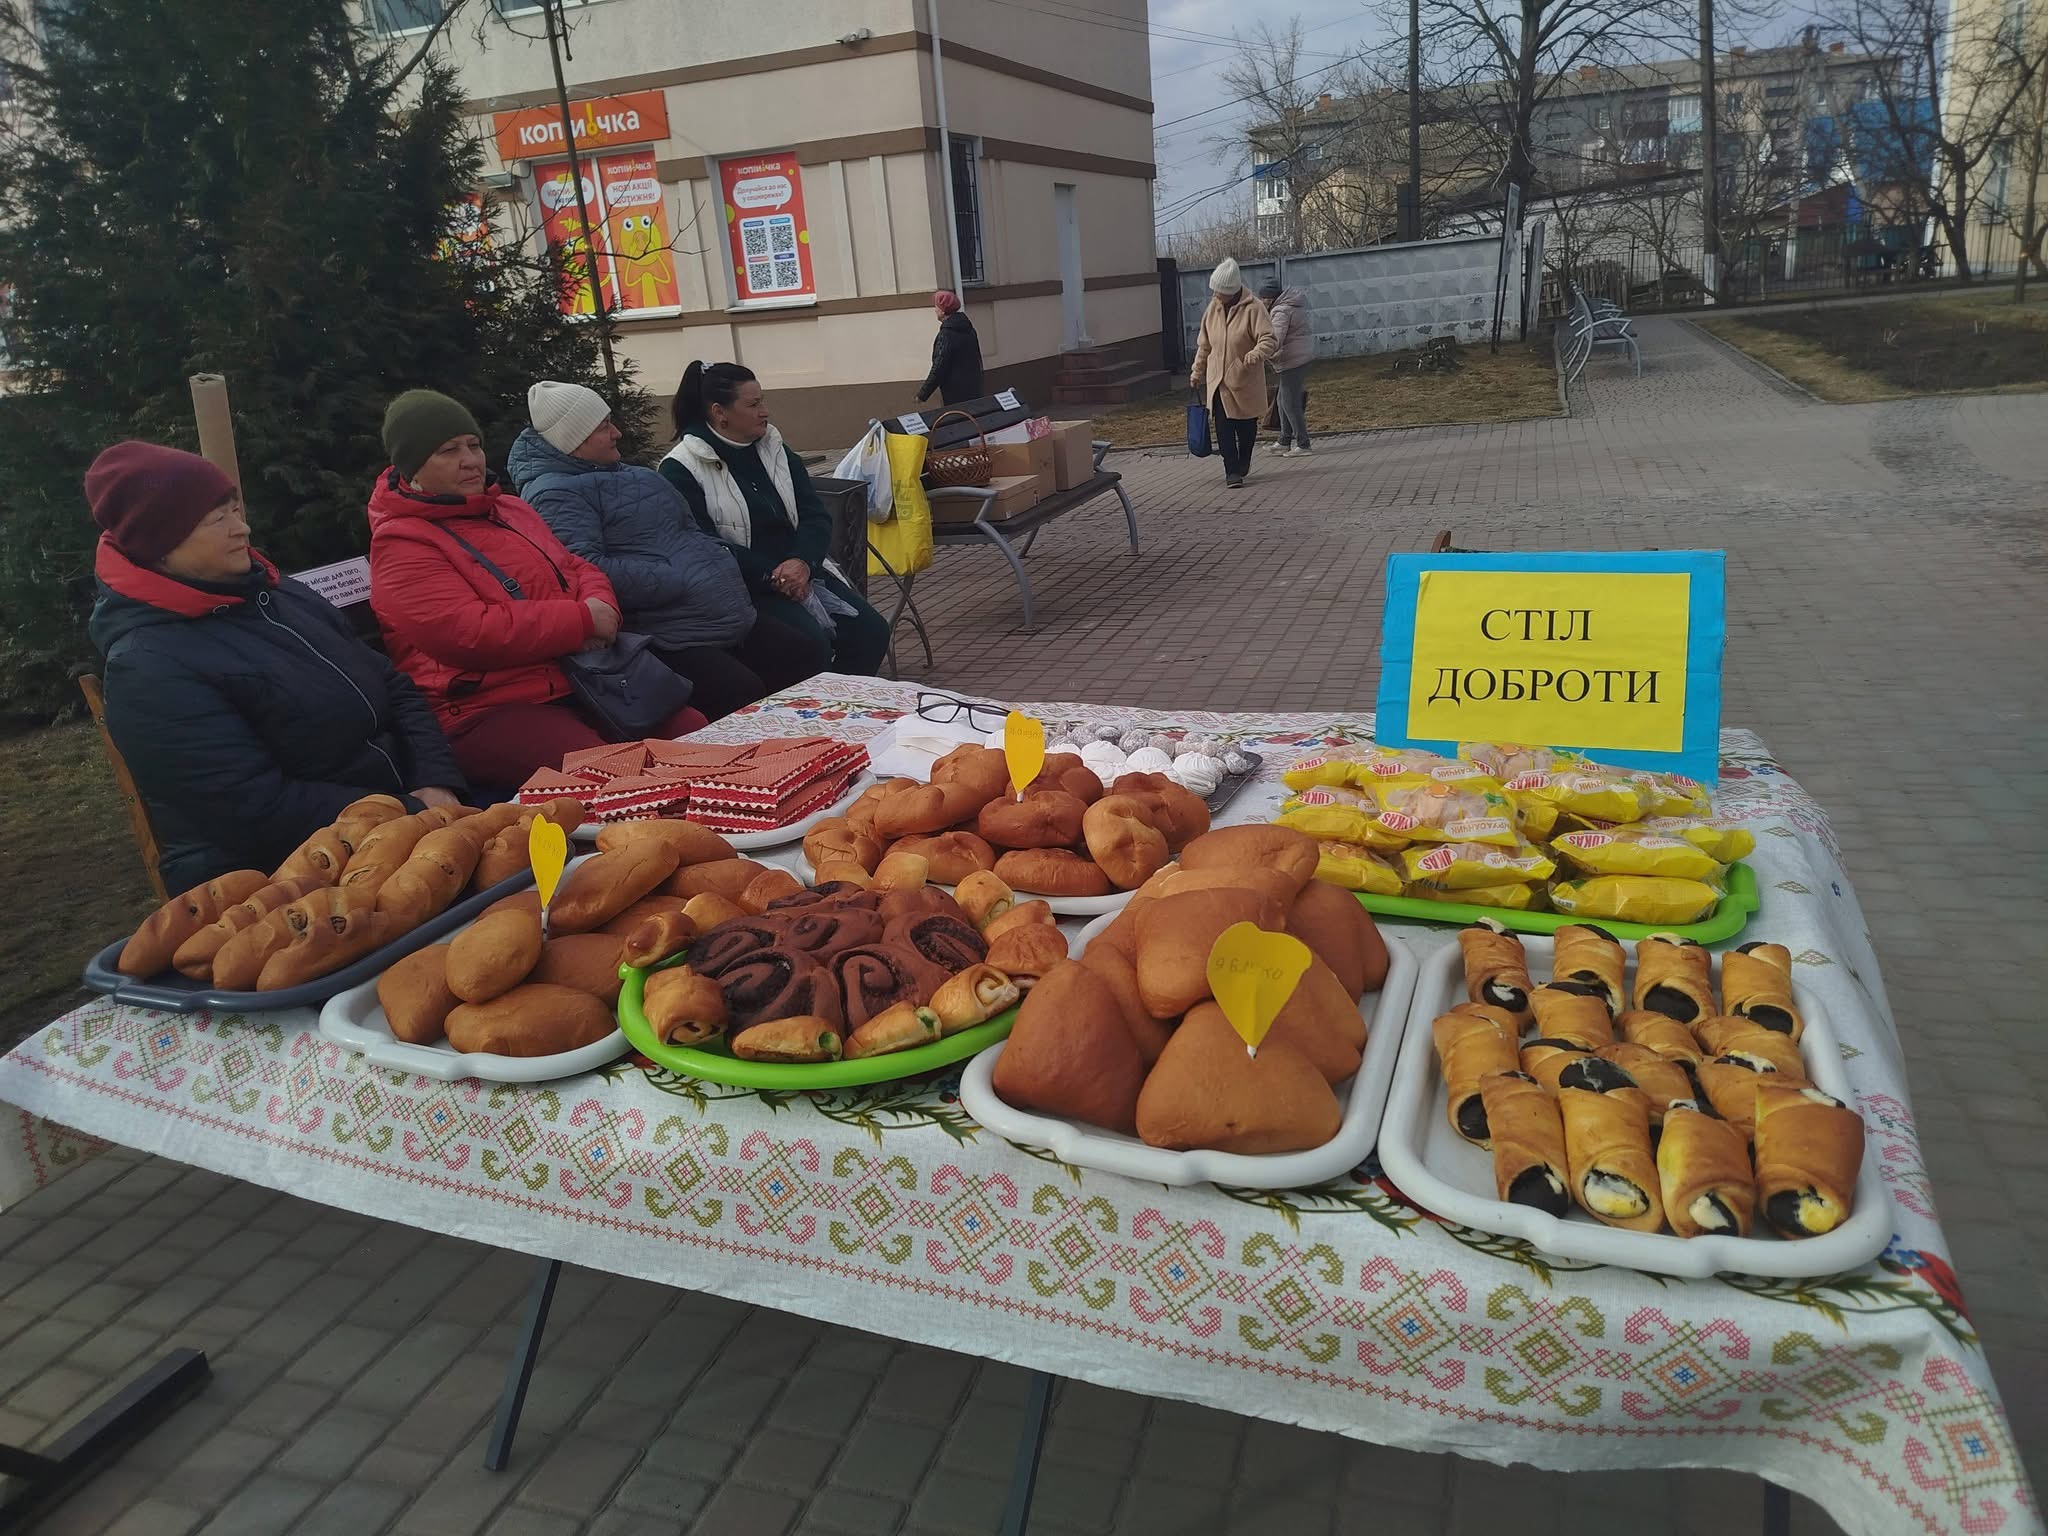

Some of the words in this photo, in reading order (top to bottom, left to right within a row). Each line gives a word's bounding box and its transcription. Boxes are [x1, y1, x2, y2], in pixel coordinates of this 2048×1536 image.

[310, 576, 330, 585] місце
[331, 571, 344, 580] для
[321, 584, 338, 594] зник
[1480, 609, 1594, 641] СТІЛ
[1427, 668, 1661, 708] ДОБРОТИ
[1291, 757, 1322, 771] LUKAS
[1568, 834, 1606, 849] LUKAS
